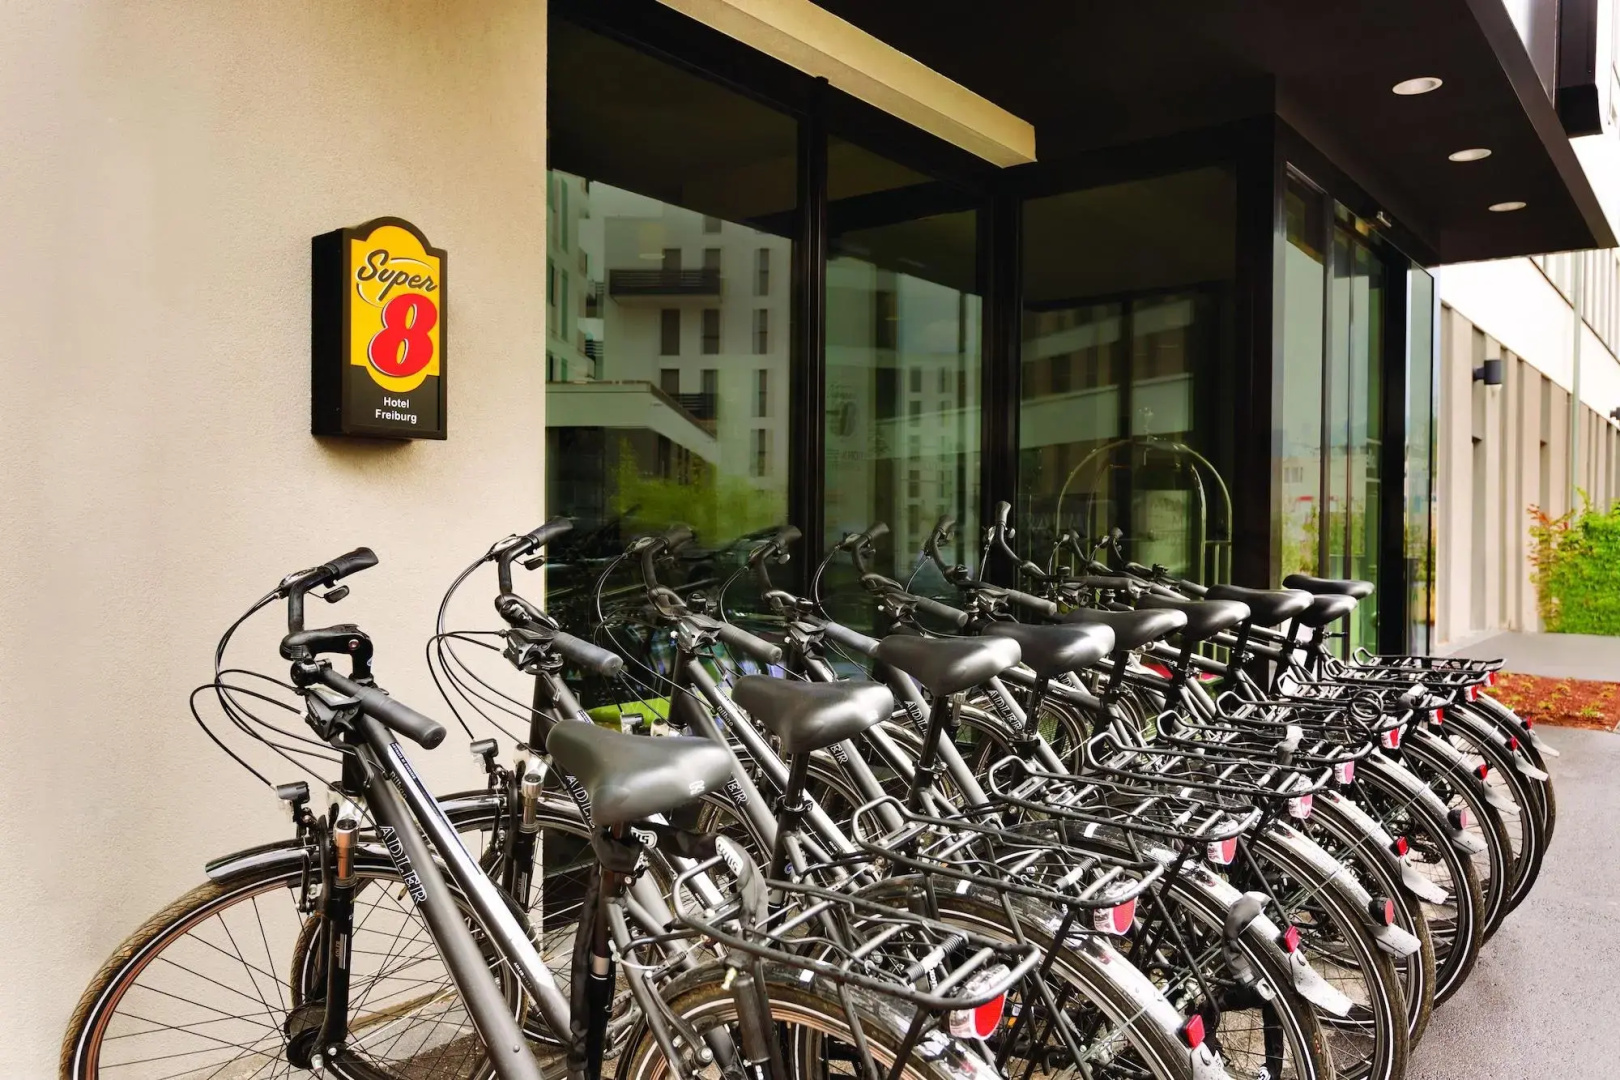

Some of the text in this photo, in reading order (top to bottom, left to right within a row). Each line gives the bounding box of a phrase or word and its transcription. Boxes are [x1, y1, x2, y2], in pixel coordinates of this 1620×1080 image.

[357, 249, 438, 302] Super
[367, 293, 438, 378] 8
[375, 409, 418, 424] Freiburg
[383, 396, 410, 409] Hotel
[986, 690, 1023, 731] ADLER
[379, 826, 428, 904] ADLER
